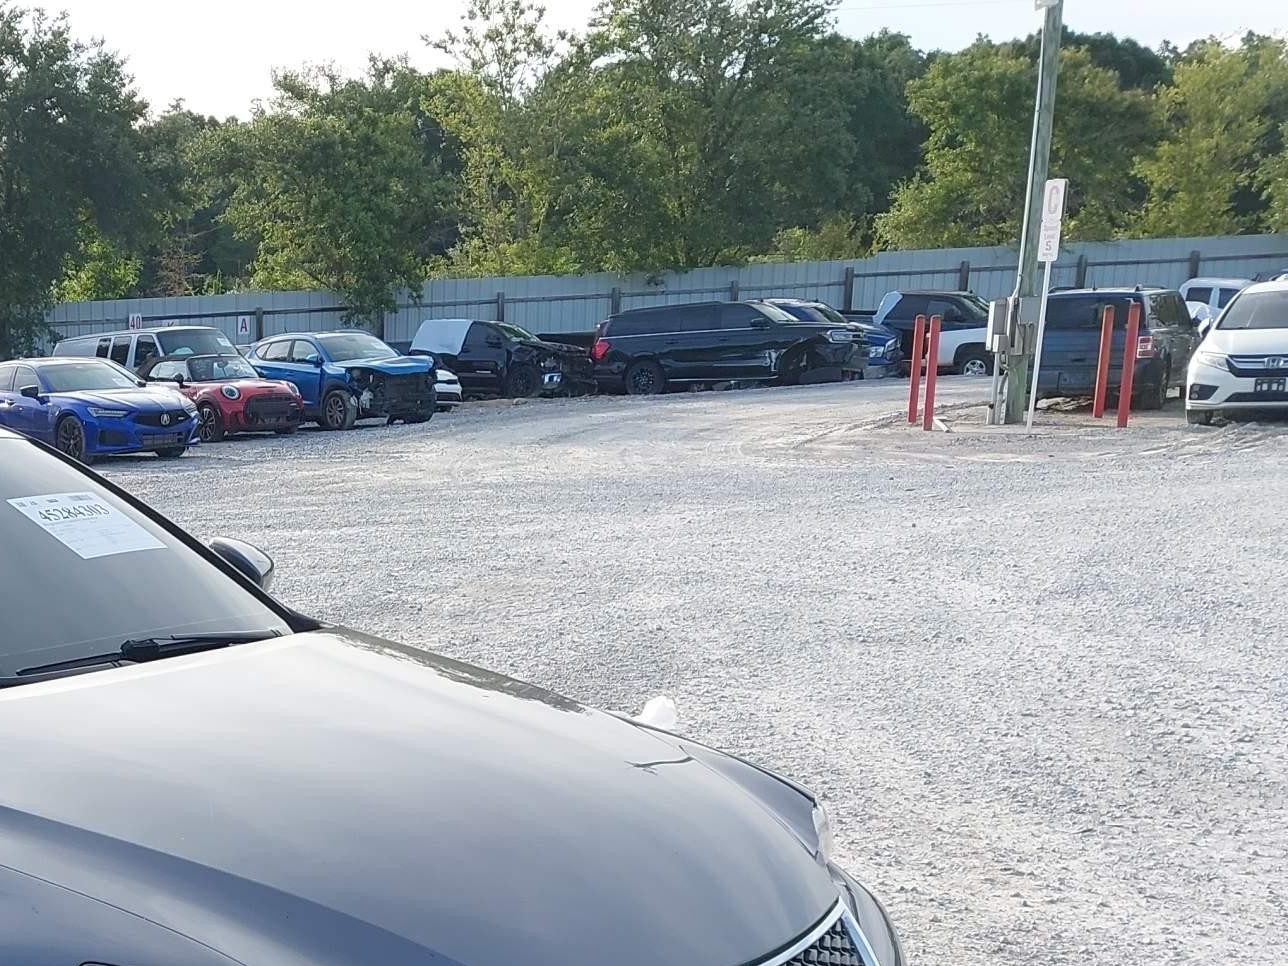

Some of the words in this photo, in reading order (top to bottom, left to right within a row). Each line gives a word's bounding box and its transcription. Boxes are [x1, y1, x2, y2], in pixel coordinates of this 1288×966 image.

[1045, 240, 1052, 251] 5
[240, 318, 248, 332] A
[39, 503, 110, 522] 45284303
